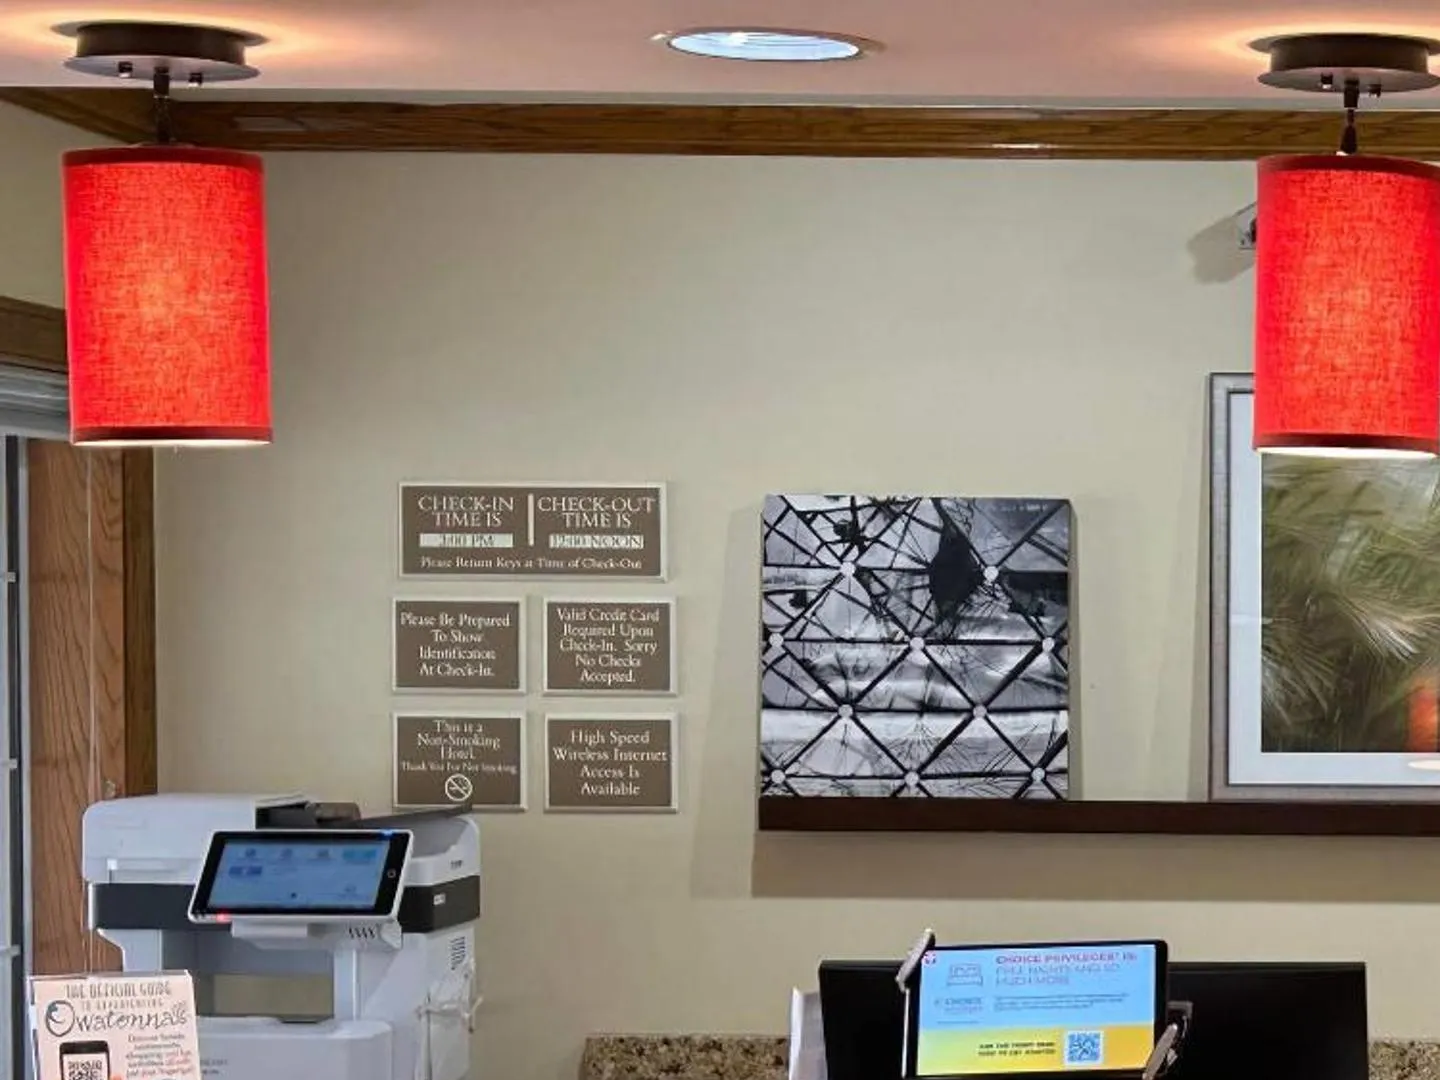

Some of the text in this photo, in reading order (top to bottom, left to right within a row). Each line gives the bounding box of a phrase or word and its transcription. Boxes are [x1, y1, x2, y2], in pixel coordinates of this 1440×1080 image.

[418, 495, 514, 512] CHECK-IN
[537, 496, 657, 513] CHECK-OUT
[432, 511, 502, 527] TIME IS
[563, 512, 632, 528] TIME IS
[420, 556, 451, 568] Please
[455, 556, 493, 568] Return
[496, 556, 522, 570] Keys
[567, 557, 579, 569] of
[581, 557, 643, 570] Check-Out
[401, 612, 510, 629] Please Be Prepared
[557, 607, 660, 622] Valid Credit Card
[431, 629, 484, 642] To Show
[563, 623, 654, 640] Required Upon
[419, 646, 496, 659] Identification
[560, 638, 658, 655] Check-In. Sorry
[575, 654, 641, 667] No Checks
[420, 662, 434, 676] At
[417, 733, 500, 750] Non-Smoking
[571, 729, 650, 747] High Speed
[552, 746, 667, 761] Wireless Internet
[581, 764, 624, 778] Access
[581, 781, 641, 795] Available
[90, 982, 137, 998] OFFICIAL
